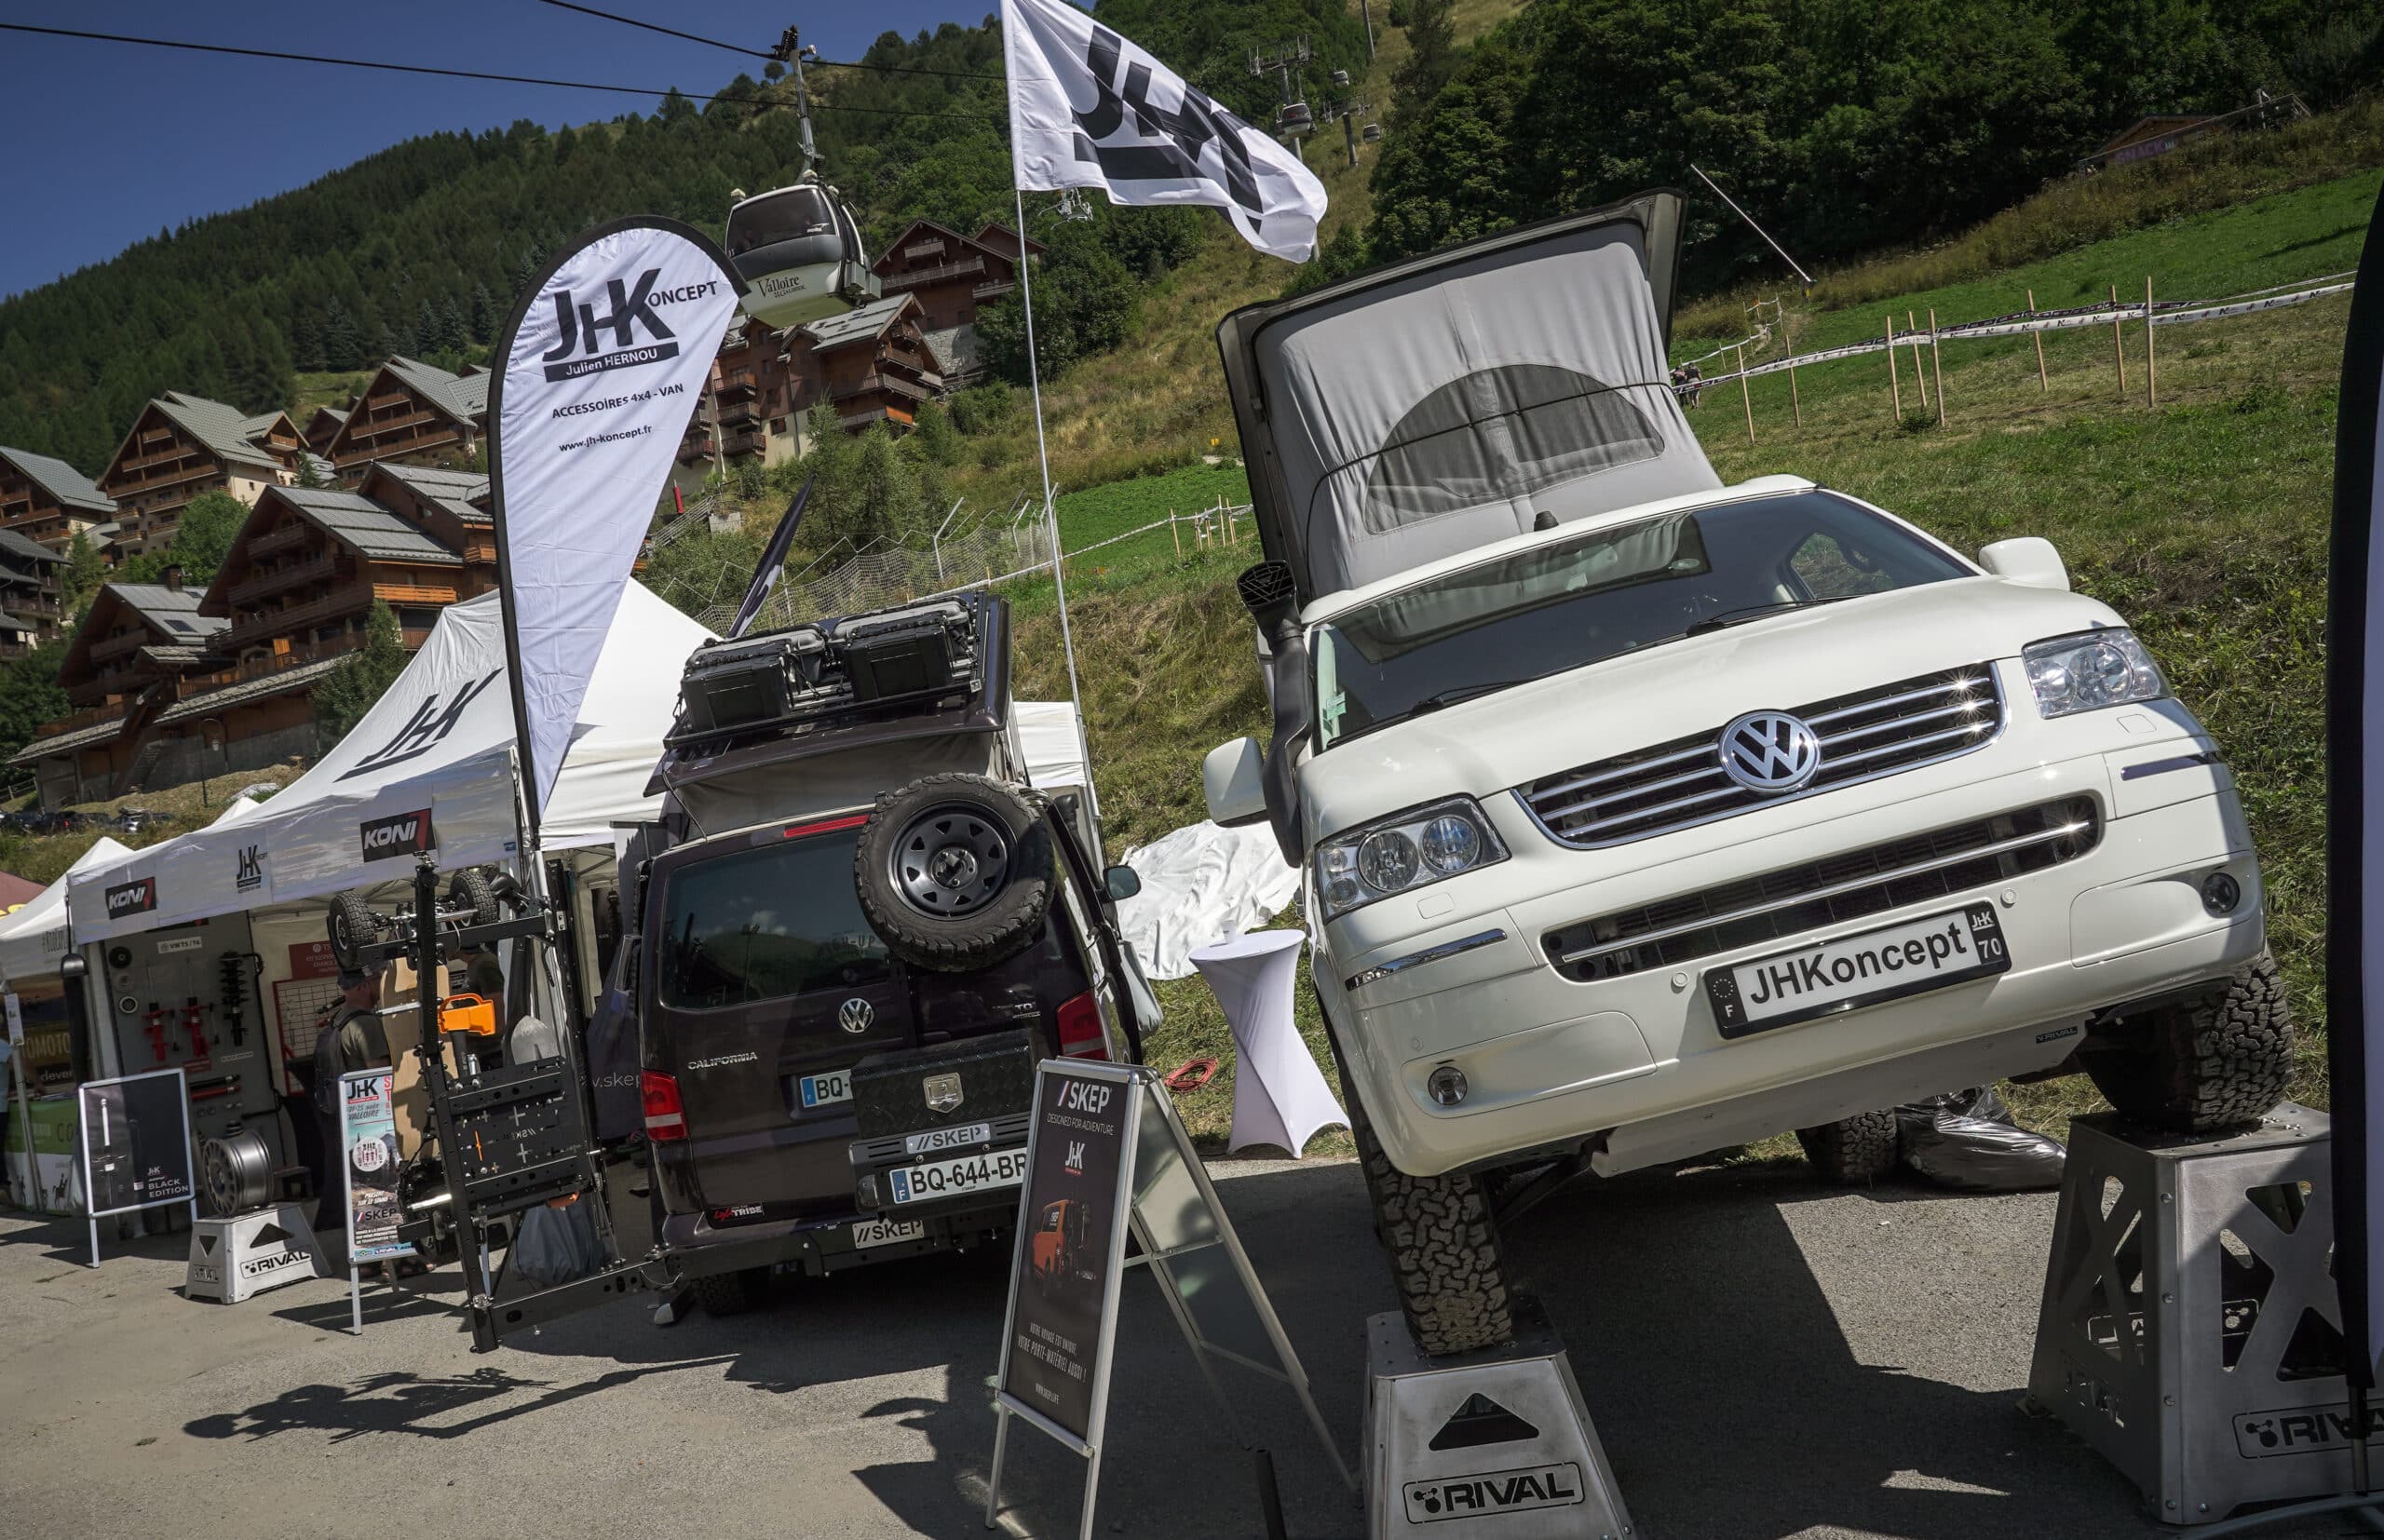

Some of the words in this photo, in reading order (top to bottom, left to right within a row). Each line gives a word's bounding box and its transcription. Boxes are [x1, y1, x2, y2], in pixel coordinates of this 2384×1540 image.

[757, 276, 800, 297] Valloire
[565, 359, 603, 376] Julien
[604, 348, 657, 367] HERNOU
[630, 390, 652, 402] 4x4
[658, 383, 684, 397] VAN
[559, 425, 653, 452] www.jh-koncept.fr
[364, 820, 417, 850] KONI
[108, 885, 146, 910] KONI
[1979, 938, 2001, 959] 70
[1750, 921, 1968, 1005] JHKoncept
[1725, 1004, 1734, 1018] F
[687, 1051, 759, 1071] CALIFORNIA
[1047, 1113, 1072, 1127] DESIGNED
[1071, 1117, 1082, 1128] FOR
[1082, 1120, 1115, 1136] ADVENTURE
[148, 1178, 181, 1191] BLACK
[149, 1184, 189, 1199] EDITION
[898, 1190, 907, 1201] F
[257, 1250, 310, 1272] RIVAL
[1443, 1472, 1575, 1513] RIVAL
